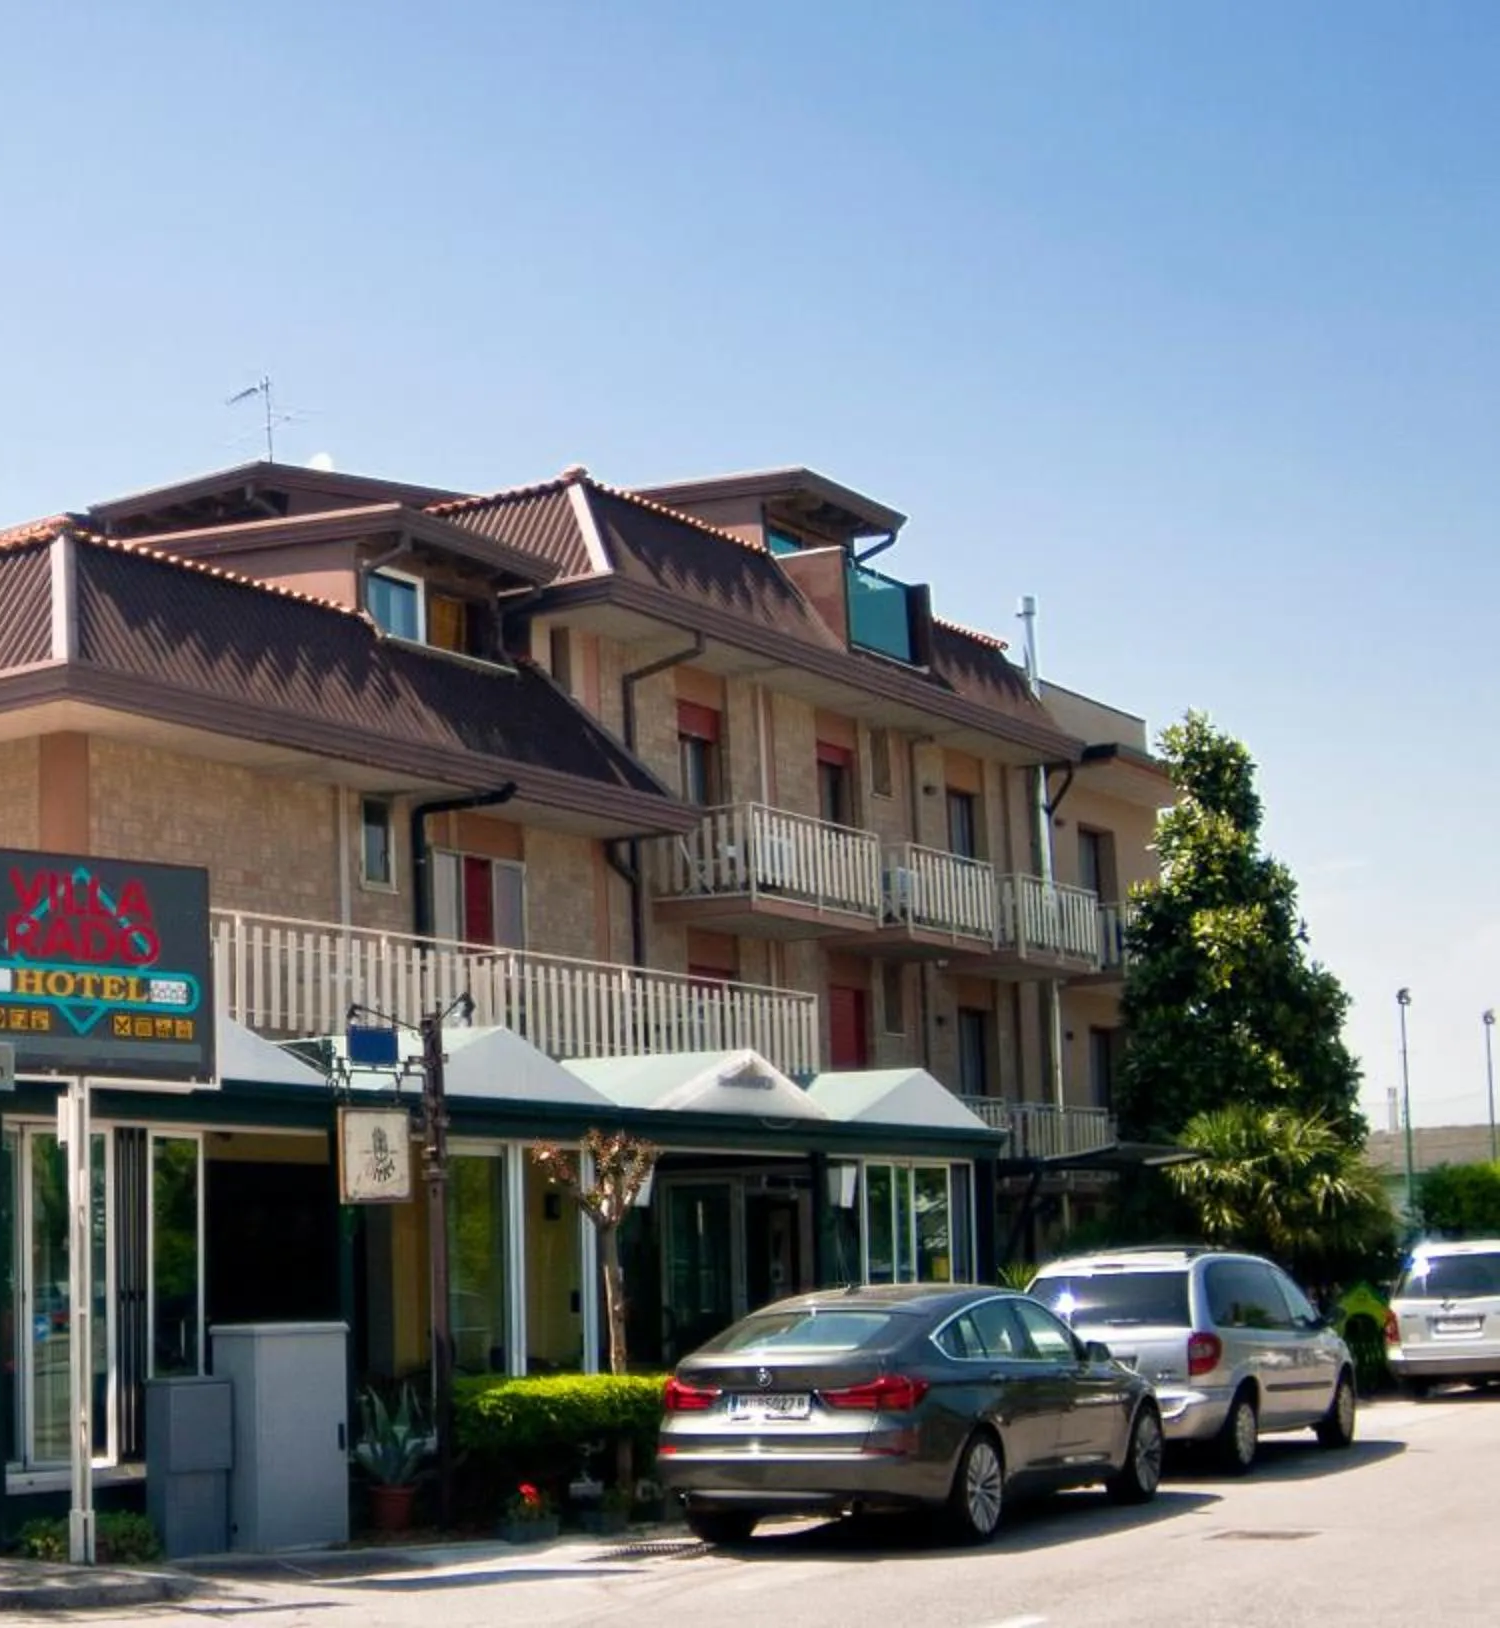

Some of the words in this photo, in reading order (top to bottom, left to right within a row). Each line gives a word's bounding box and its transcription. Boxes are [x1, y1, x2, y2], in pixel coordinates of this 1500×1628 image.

[9, 866, 152, 918] VILLA
[6, 912, 161, 964] RADO
[17, 969, 149, 1002] HOTEL
